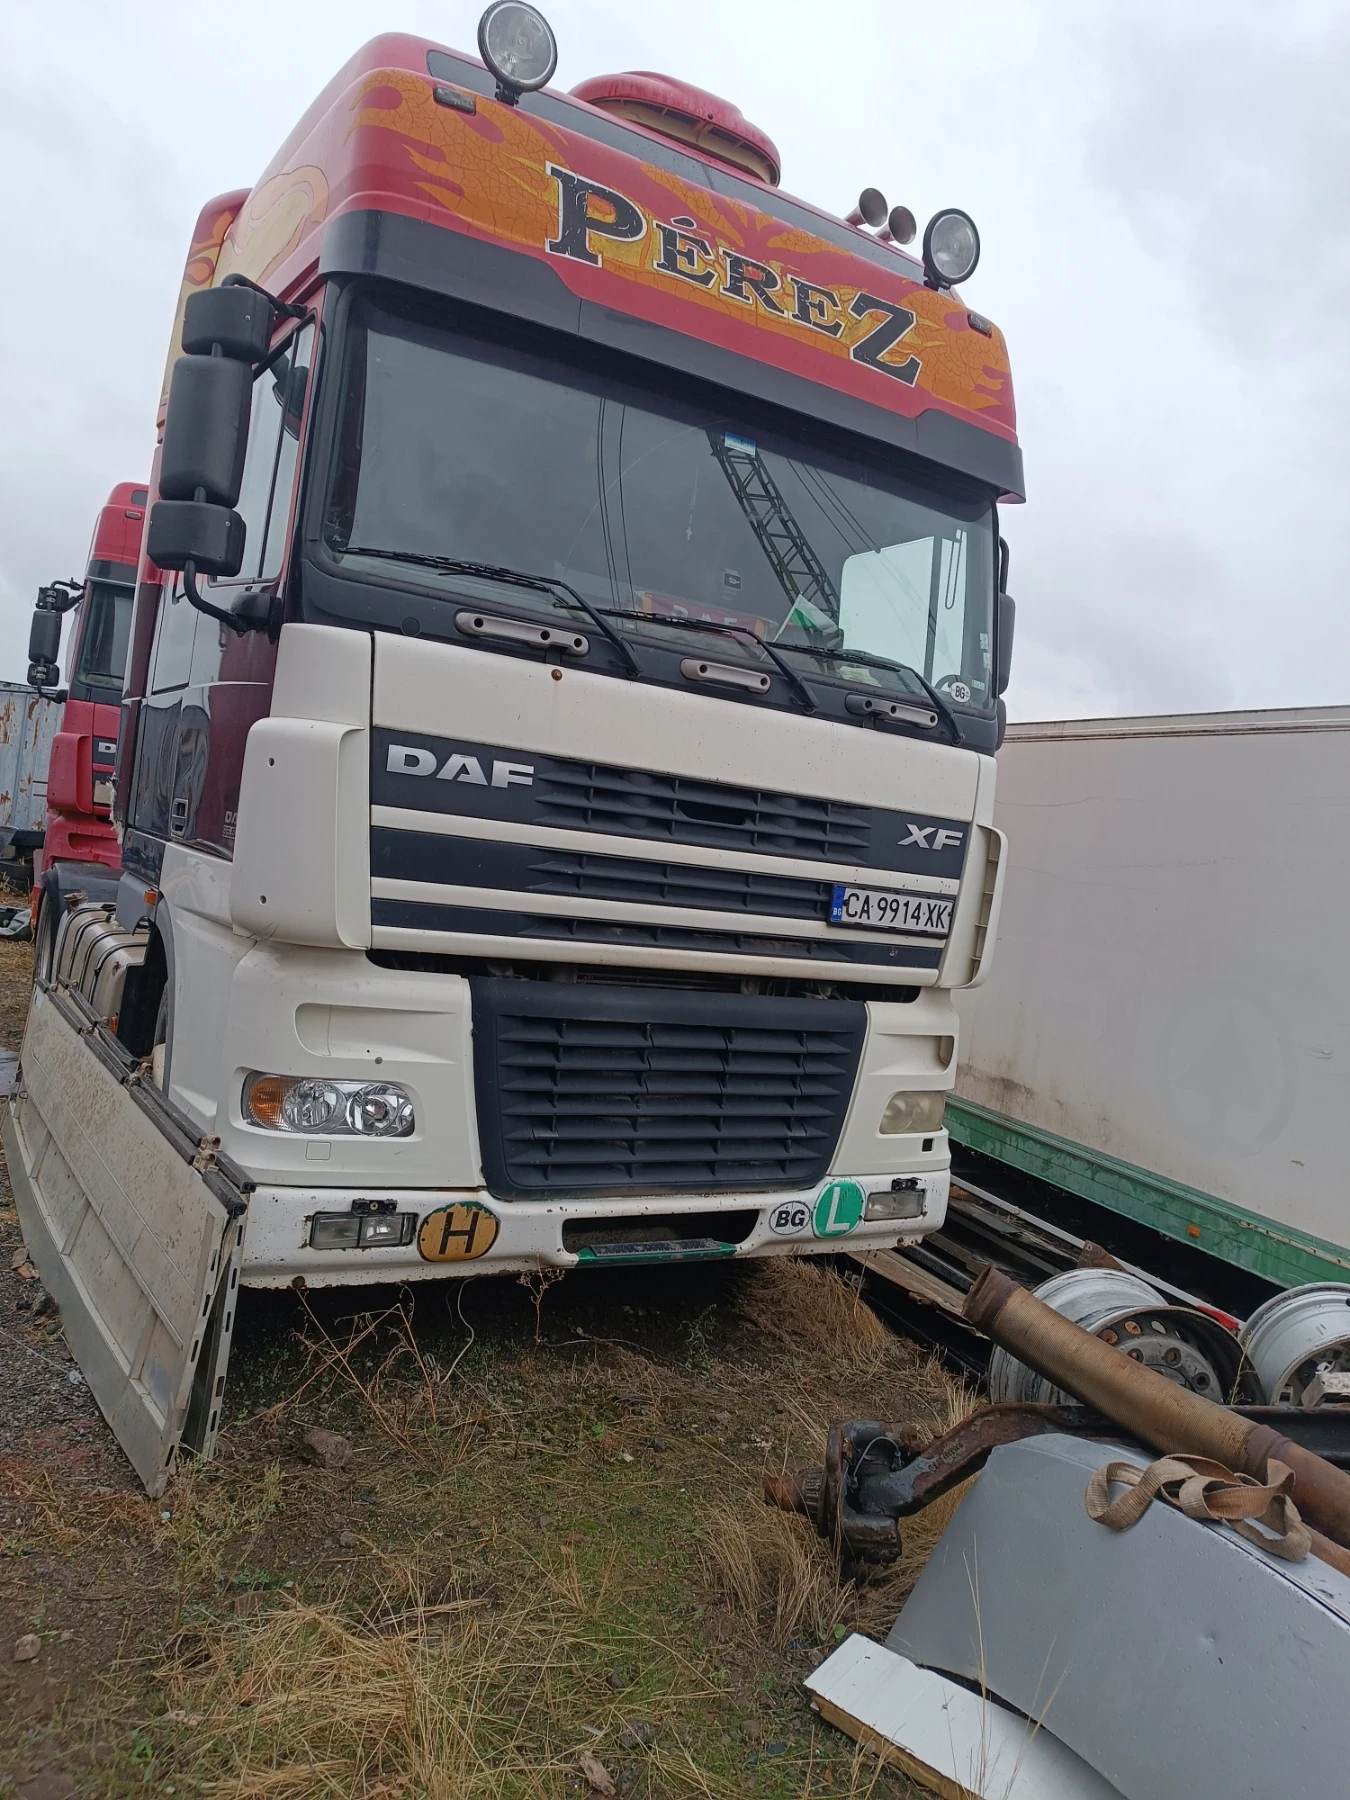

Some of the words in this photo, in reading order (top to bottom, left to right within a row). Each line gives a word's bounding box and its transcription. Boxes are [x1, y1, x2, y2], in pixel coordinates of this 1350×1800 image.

[955, 685, 966, 699] BG
[386, 744, 535, 788] DAF
[897, 823, 963, 850] XF
[832, 907, 842, 916] BG
[775, 1209, 806, 1228] BG
[824, 1187, 851, 1232] L
[438, 1212, 480, 1255] H
